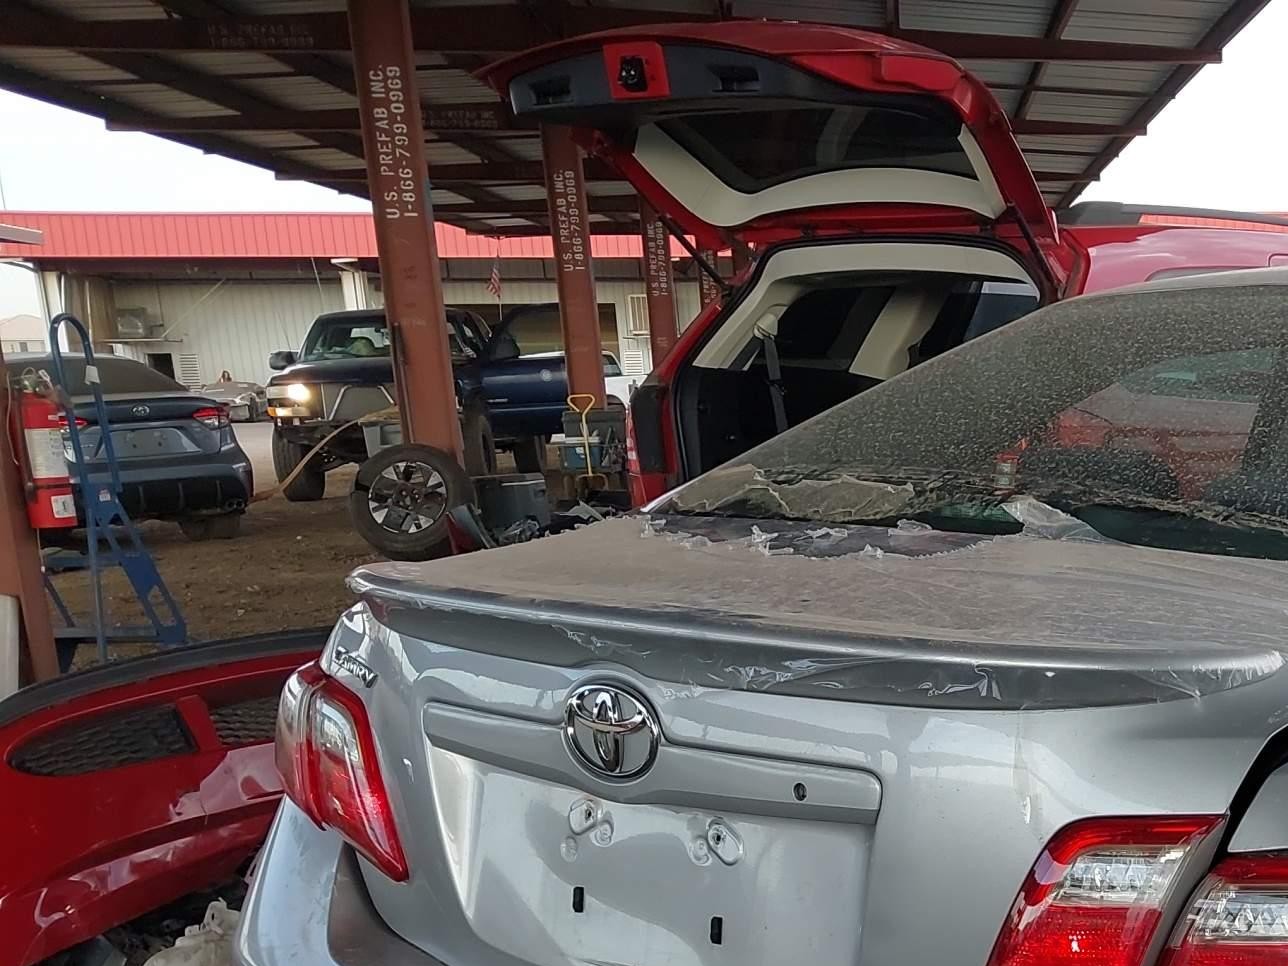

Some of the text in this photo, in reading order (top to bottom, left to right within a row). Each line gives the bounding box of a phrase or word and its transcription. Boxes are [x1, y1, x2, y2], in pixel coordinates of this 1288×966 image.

[368, 64, 400, 219] U.S. PREFAB INC.
[386, 65, 418, 218] 1-866-799-0969
[556, 197, 571, 243] PREFAB
[335, 646, 379, 688] CAMRY
